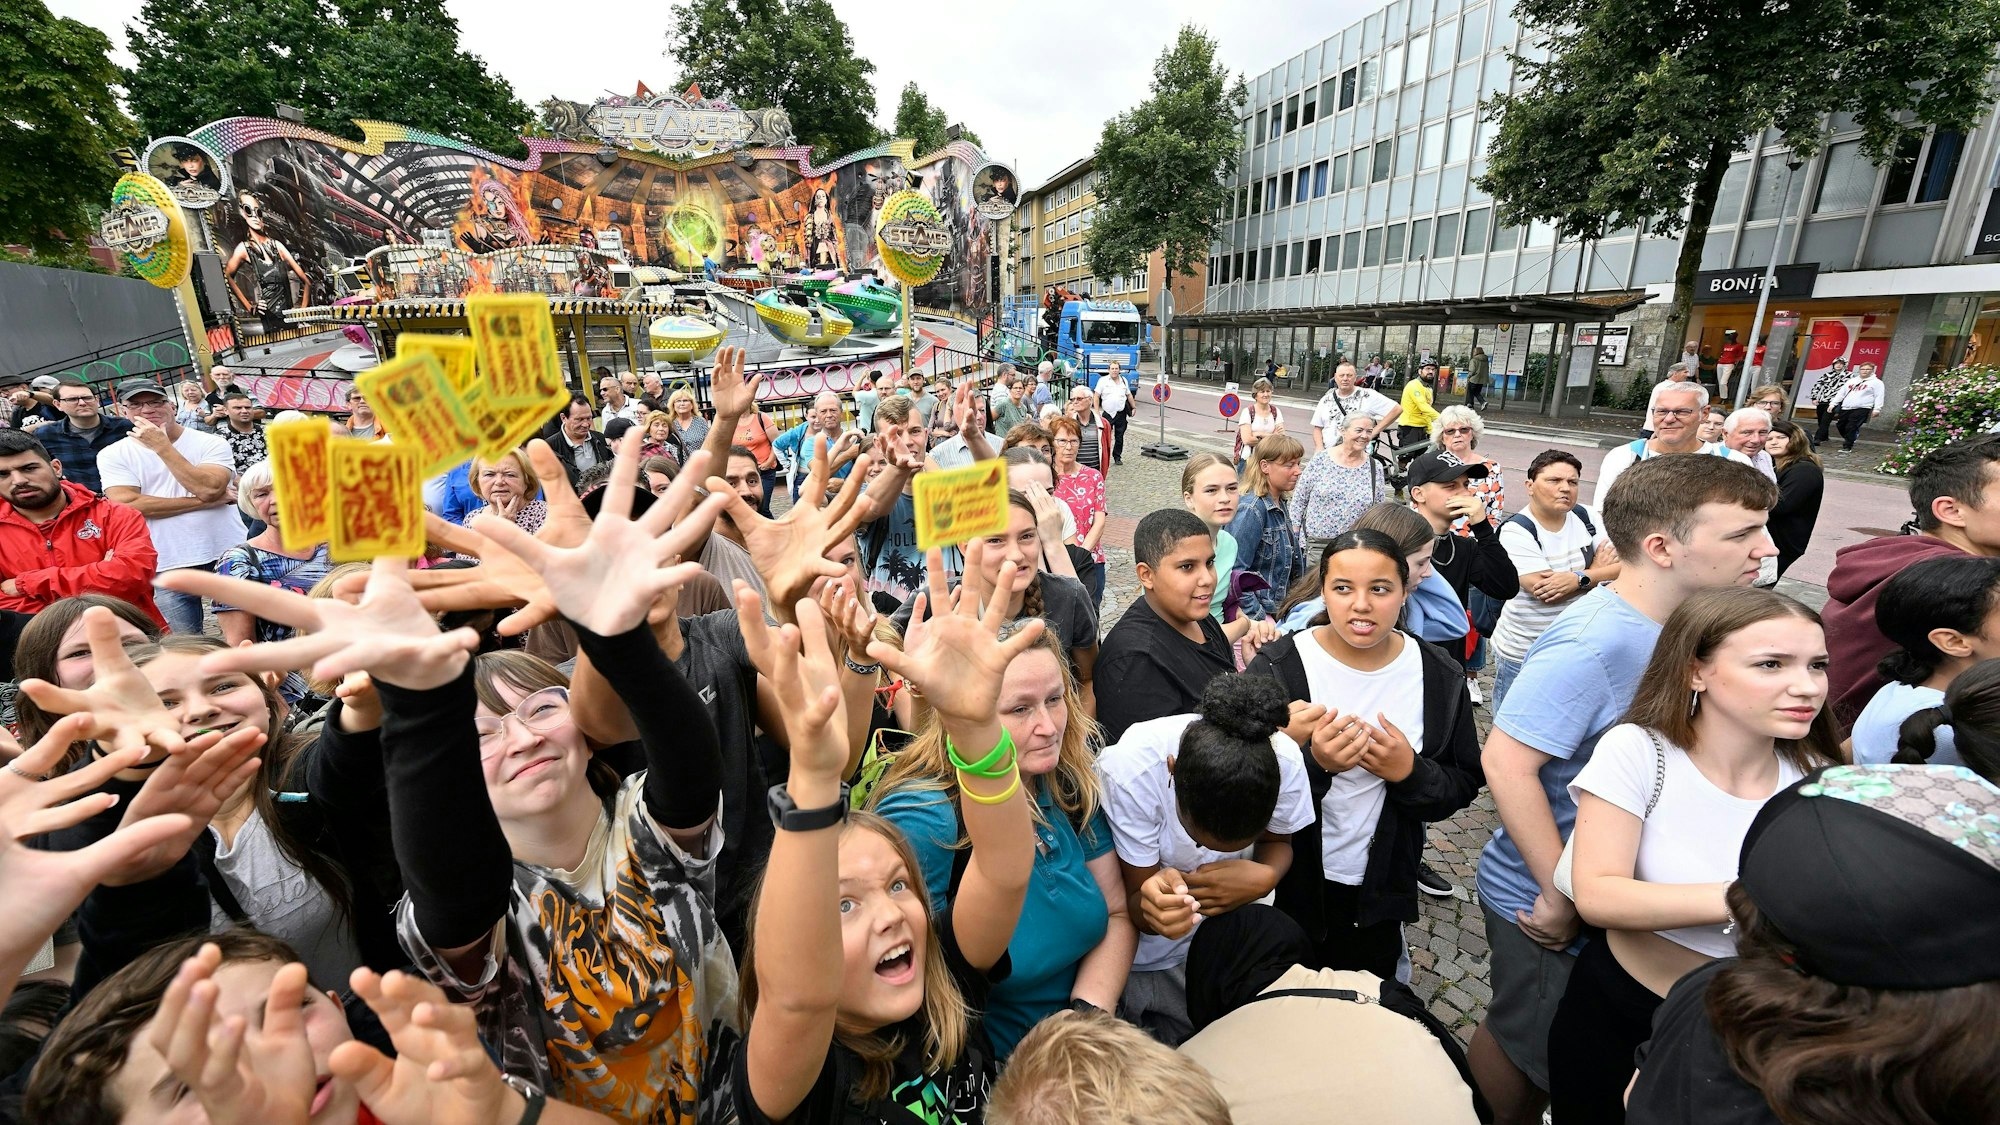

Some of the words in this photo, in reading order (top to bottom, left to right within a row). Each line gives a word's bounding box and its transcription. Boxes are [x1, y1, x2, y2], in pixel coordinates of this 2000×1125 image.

[607, 104, 736, 137] STEAMER
[106, 214, 161, 241] STEAMER
[890, 226, 948, 246] STEAMER
[1812, 341, 1842, 350] SALE
